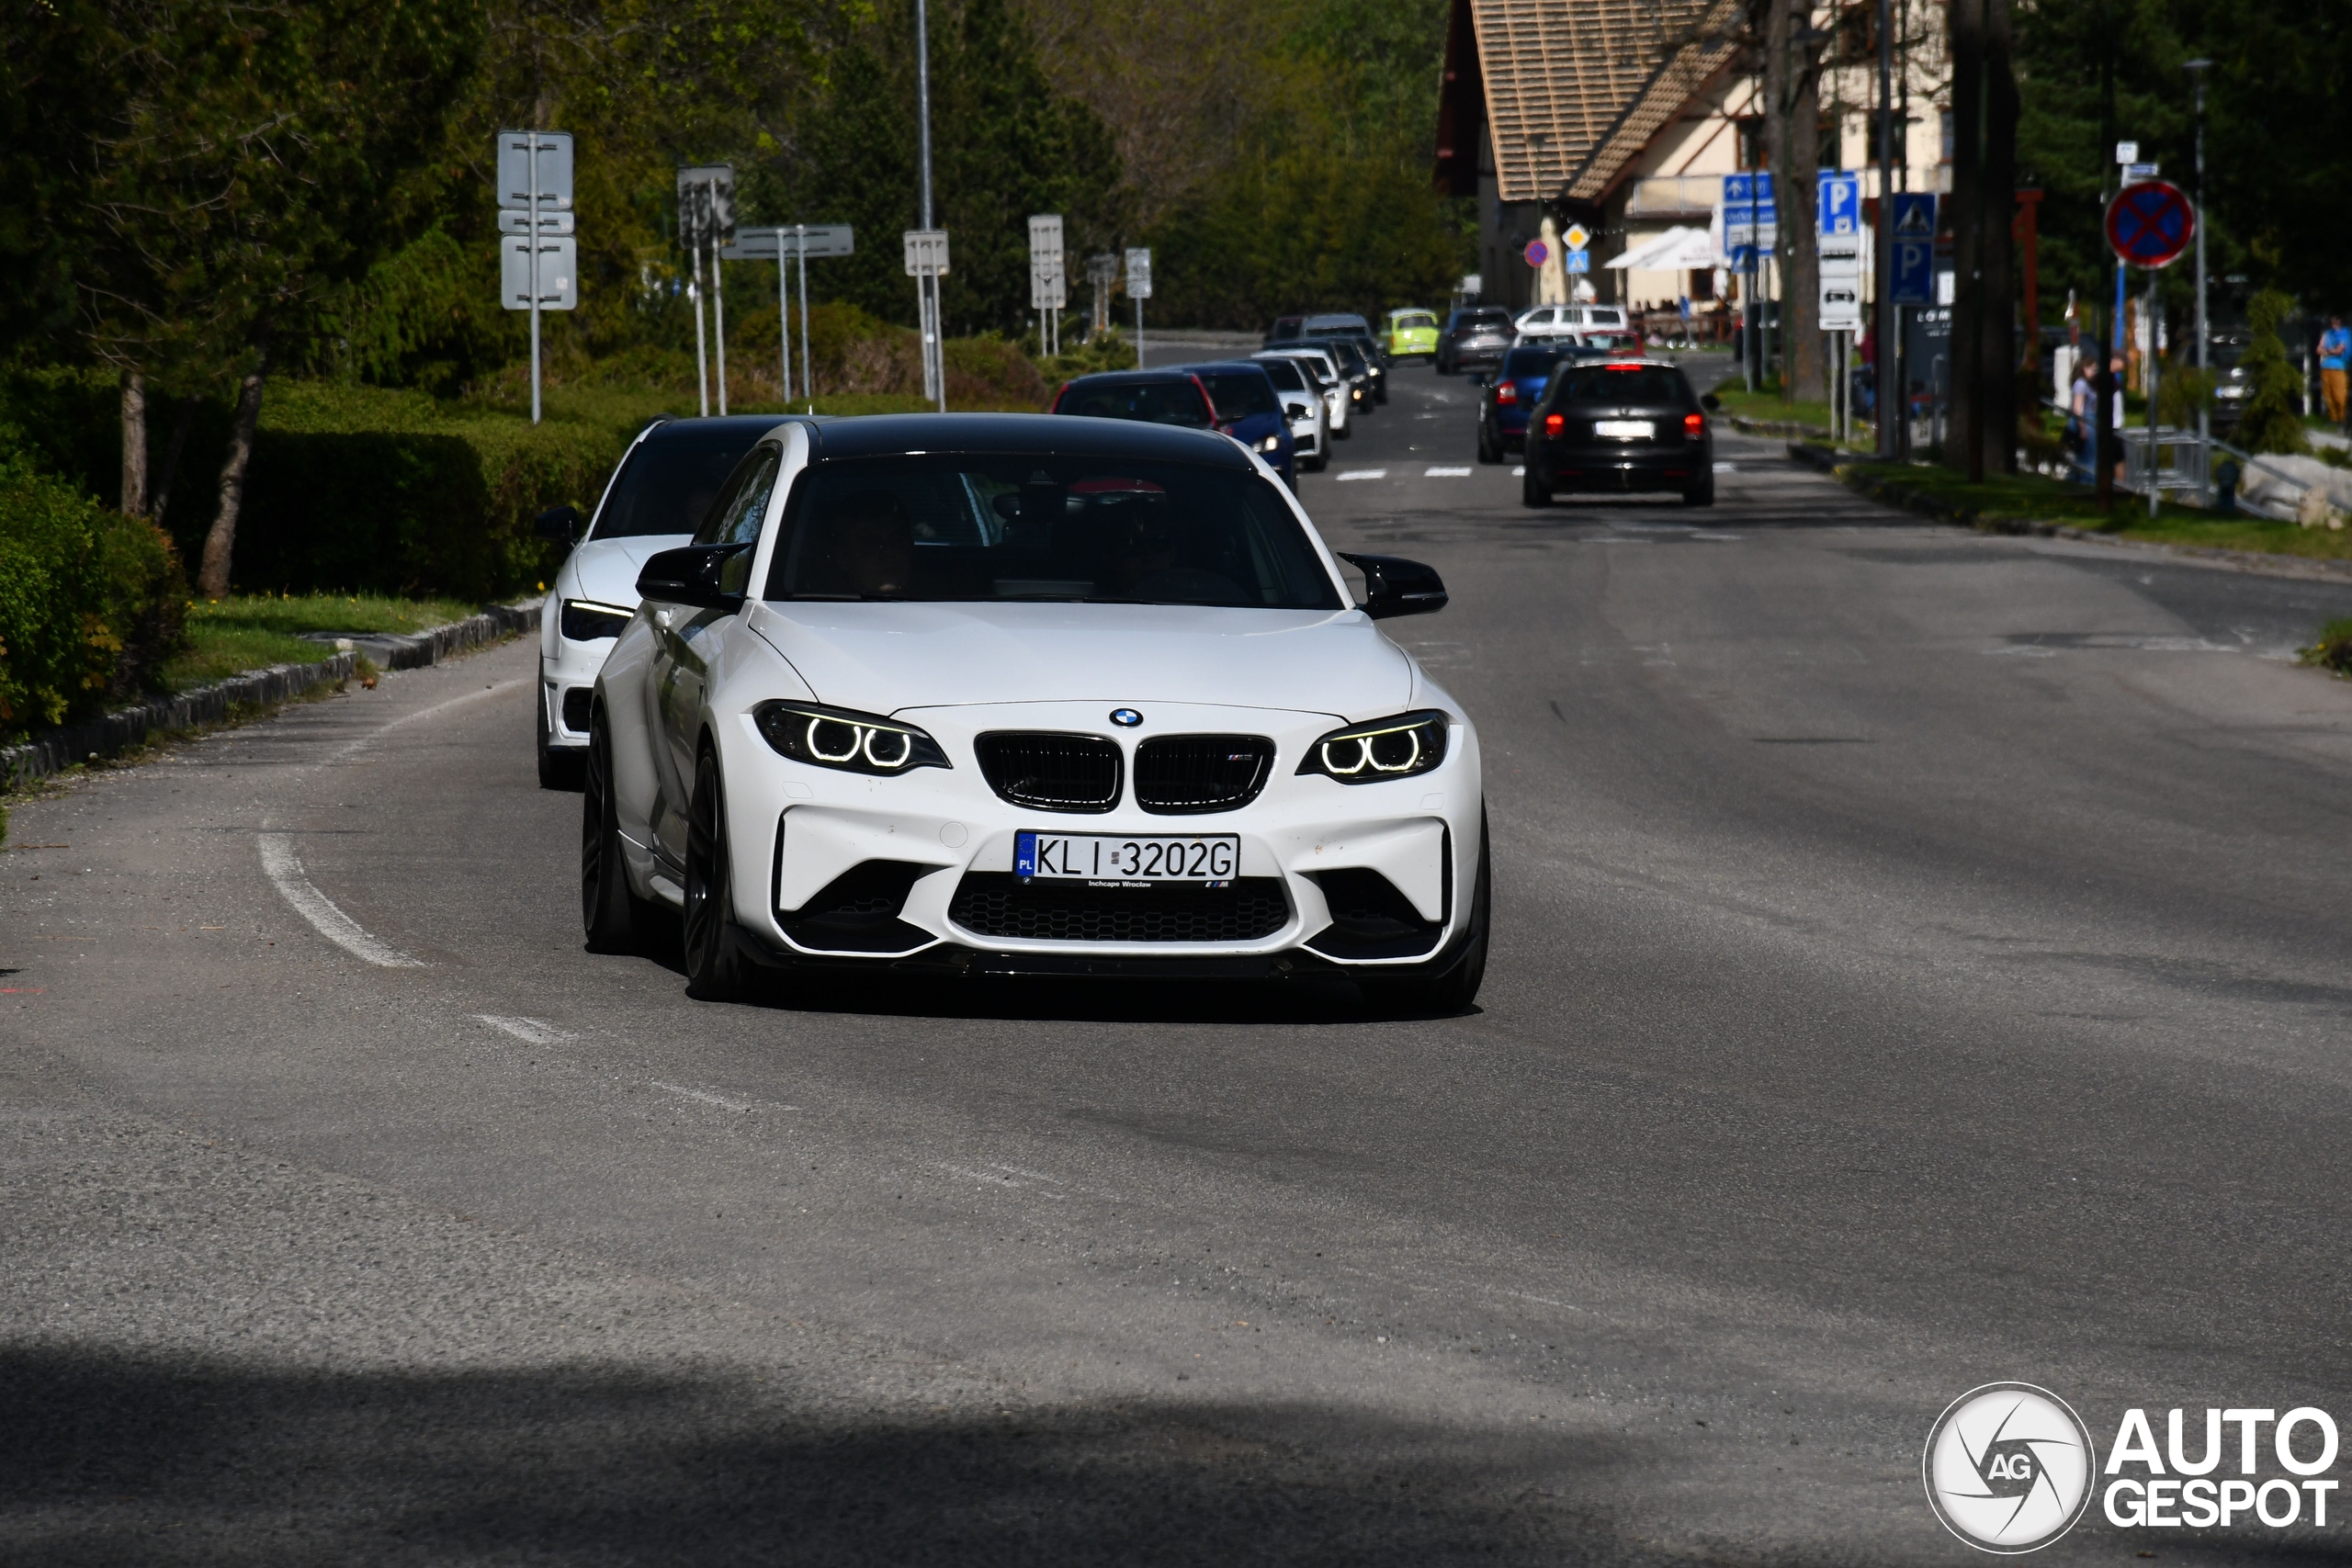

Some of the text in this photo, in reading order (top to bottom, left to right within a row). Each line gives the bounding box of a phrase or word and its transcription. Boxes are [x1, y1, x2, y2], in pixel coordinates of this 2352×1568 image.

[1831, 183, 1849, 215] P
[1901, 245, 1922, 280] P
[1019, 860, 1033, 870] PL
[1121, 841, 1232, 876] 3202G
[1088, 880, 1120, 888] Inchcape
